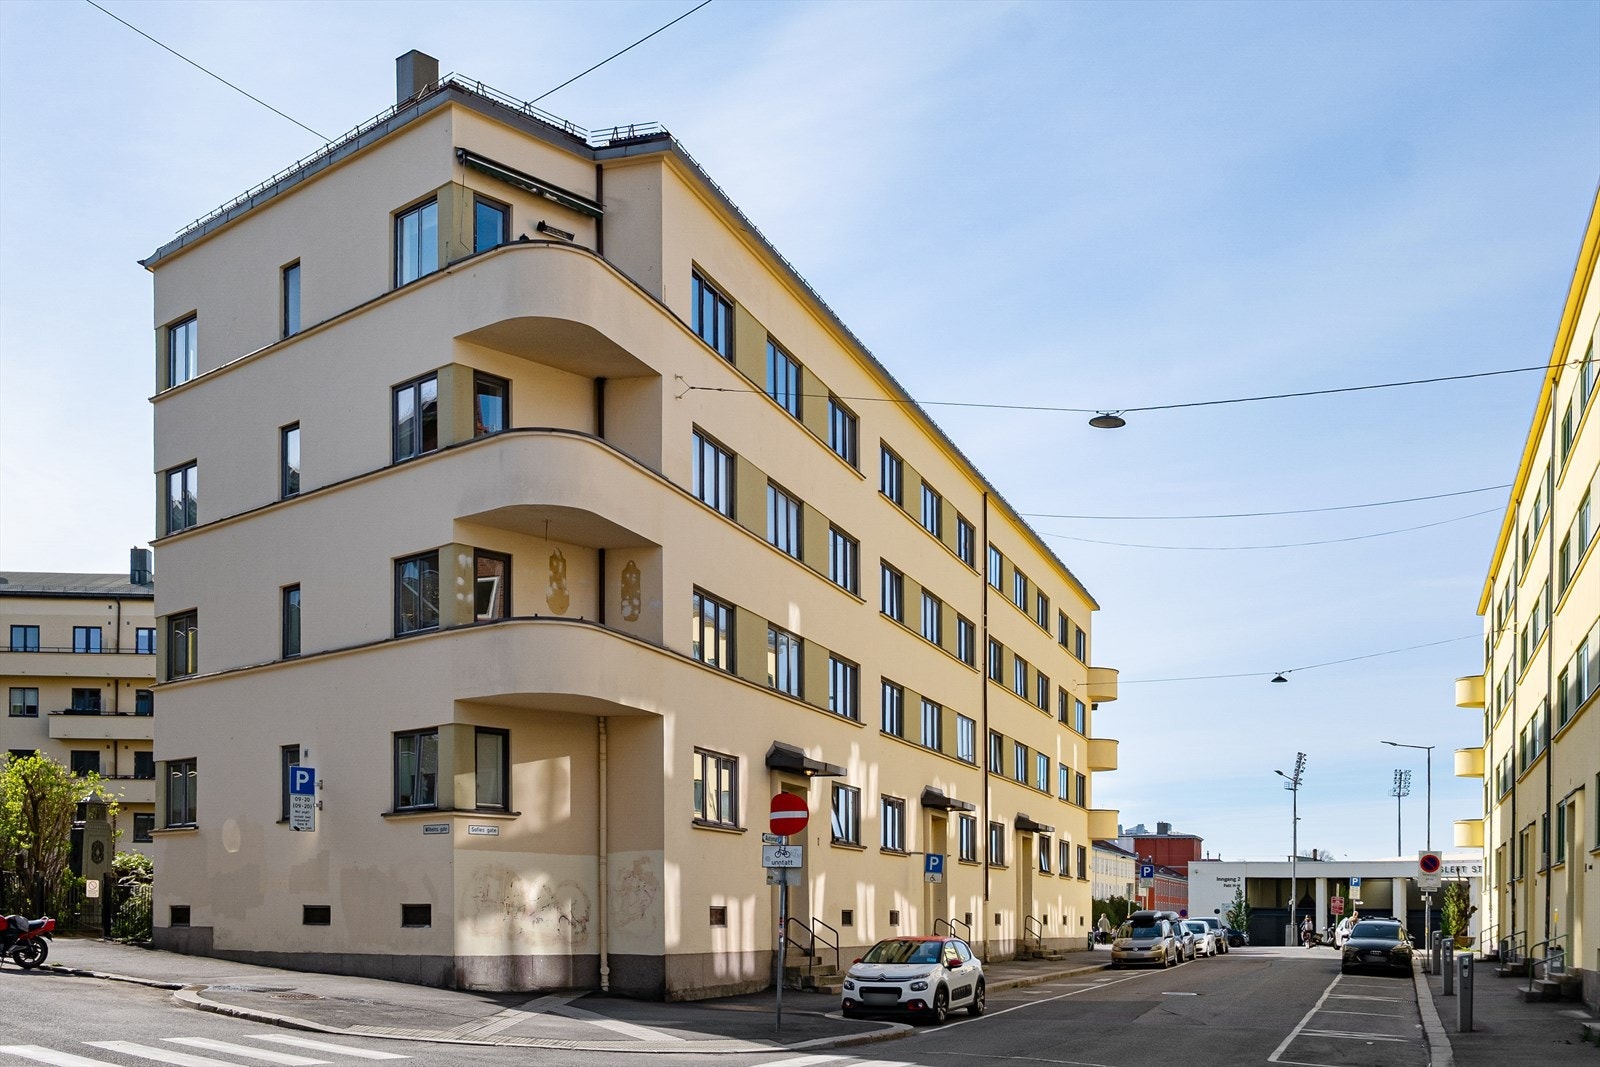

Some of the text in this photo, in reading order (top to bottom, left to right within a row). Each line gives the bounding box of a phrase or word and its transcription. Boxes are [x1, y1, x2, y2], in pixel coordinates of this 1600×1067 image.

[296, 770, 310, 791] P
[929, 856, 940, 870] P
[1143, 866, 1151, 877] P
[1352, 877, 1358, 885] P
